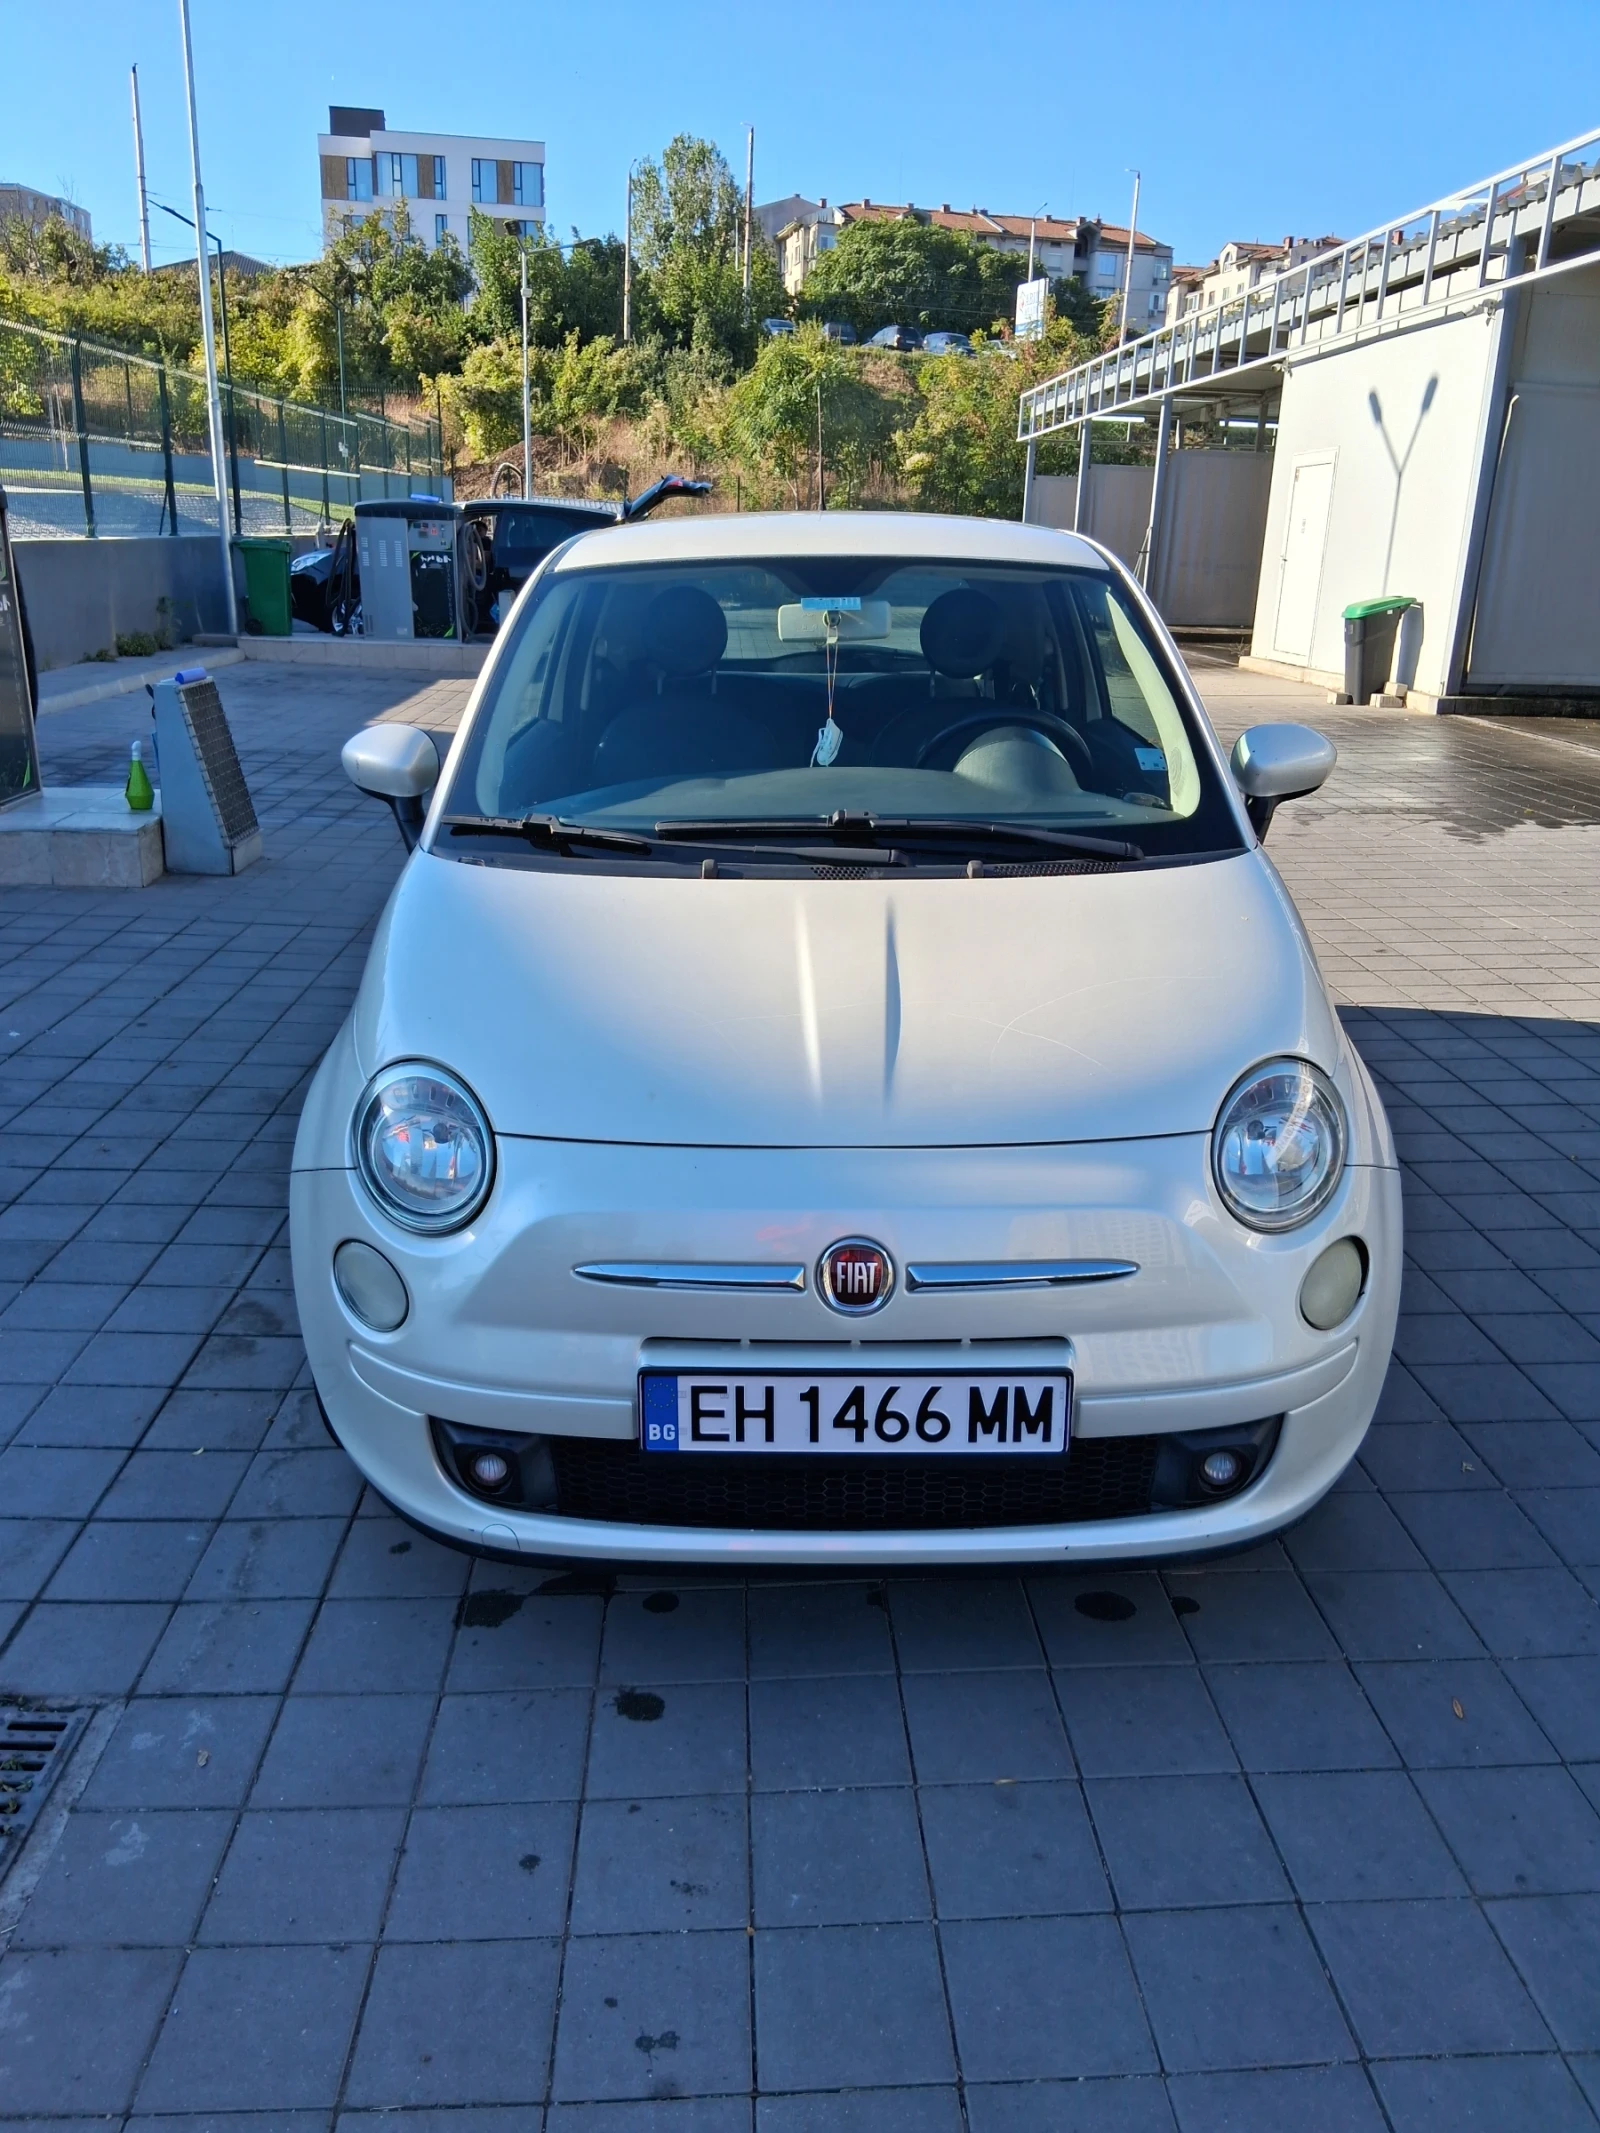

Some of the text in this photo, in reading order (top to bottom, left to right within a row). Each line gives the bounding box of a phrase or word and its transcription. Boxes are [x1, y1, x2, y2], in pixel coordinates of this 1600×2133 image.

[836, 1261, 879, 1294] FIAT
[690, 1385, 1054, 1443] EH 1466 MM
[648, 1423, 676, 1441] BG
